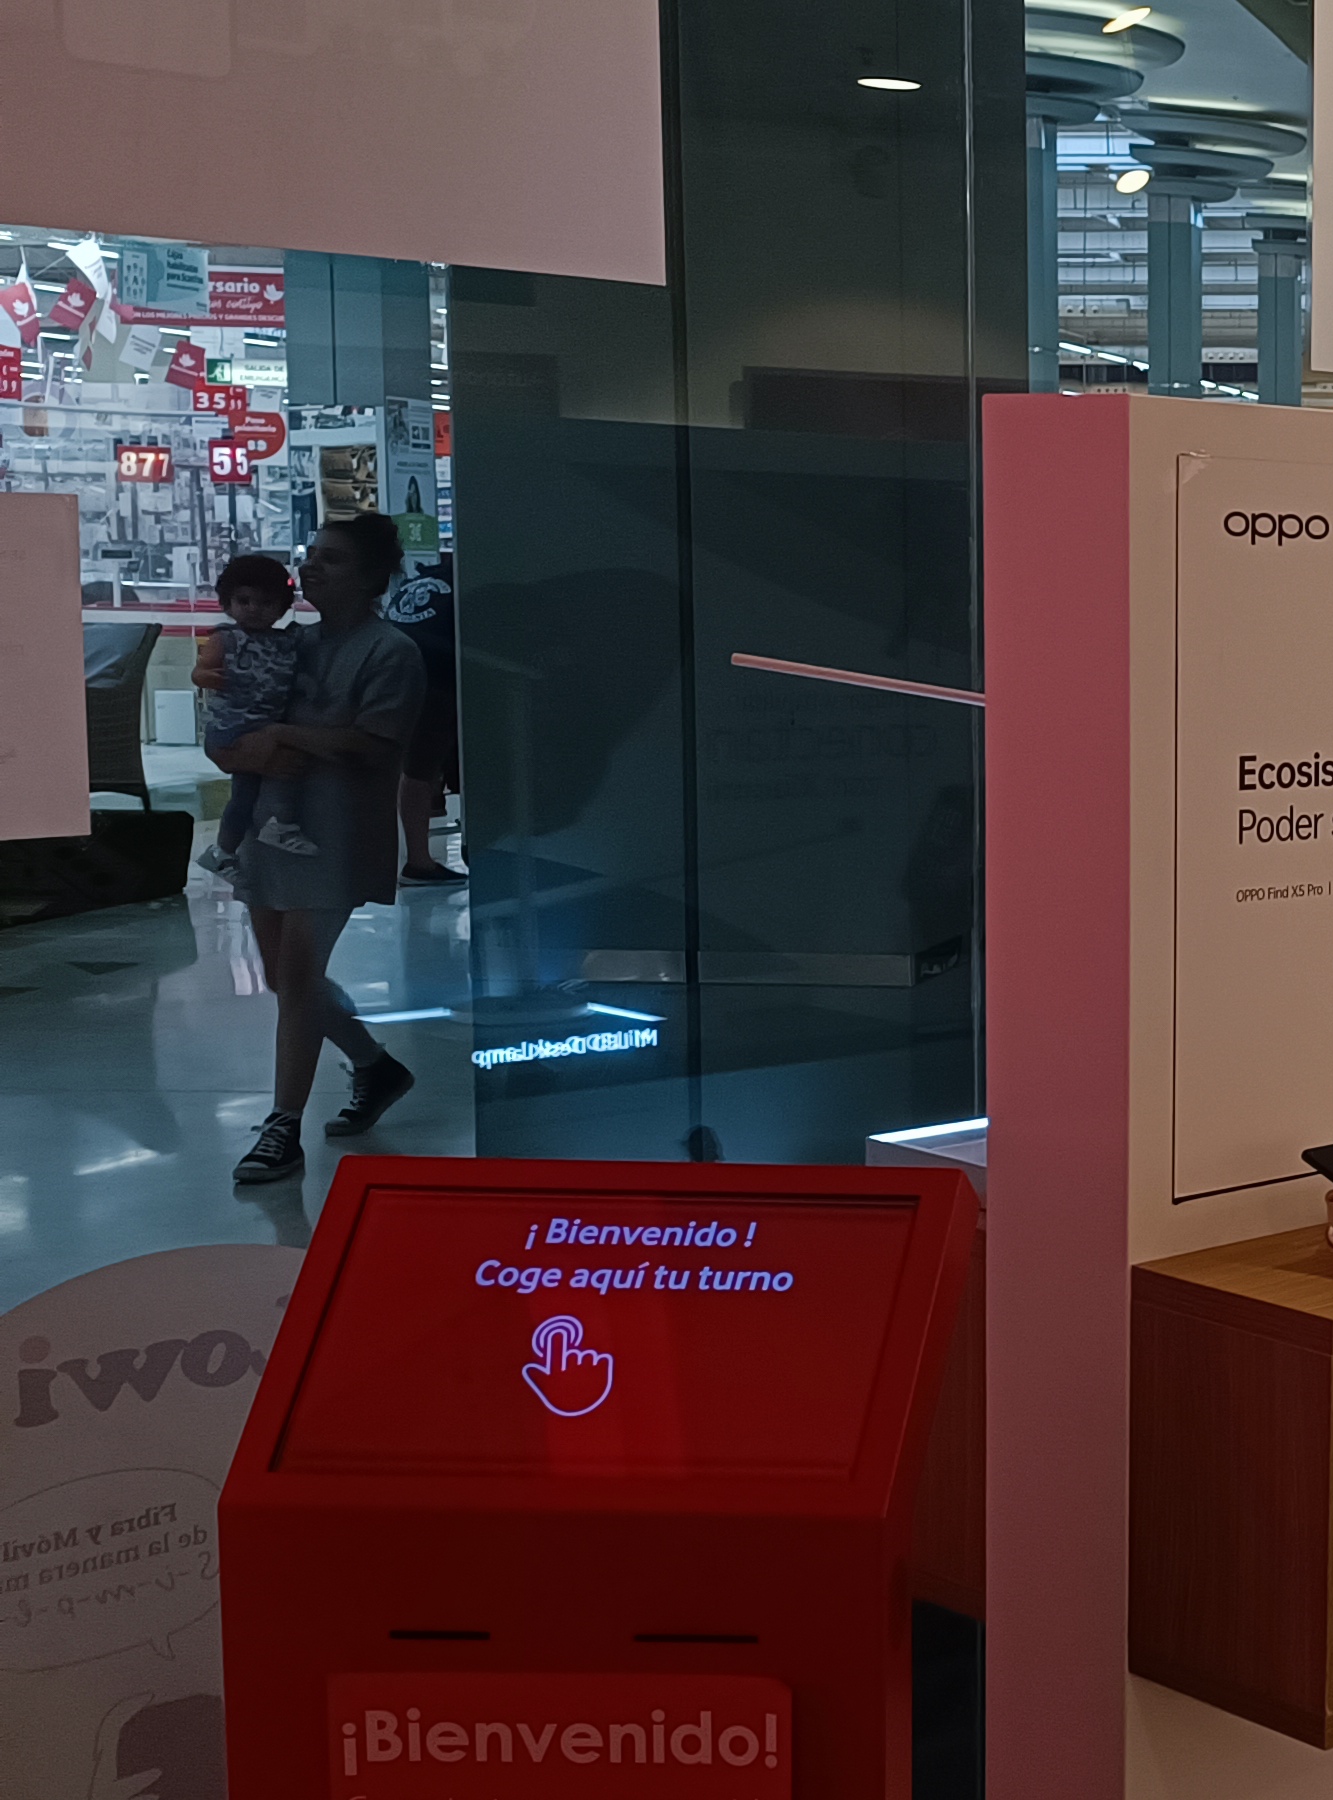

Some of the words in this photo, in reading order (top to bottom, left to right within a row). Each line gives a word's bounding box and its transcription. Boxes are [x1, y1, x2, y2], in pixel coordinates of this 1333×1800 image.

[1223, 511, 1330, 546] oppo
[1238, 805, 1324, 844] Poder
[1236, 887, 1265, 903] OPPO
[1267, 884, 1289, 900] Find
[1291, 884, 1305, 897] X5
[1307, 883, 1323, 897] Pro
[545, 1218, 737, 1247] Bienvenido
[474, 1259, 562, 1294] Coge
[569, 1261, 650, 1295] aquí
[653, 1265, 690, 1290] tu
[698, 1266, 794, 1292] turno
[342, 1707, 778, 1777] ¡Bienvenido!
